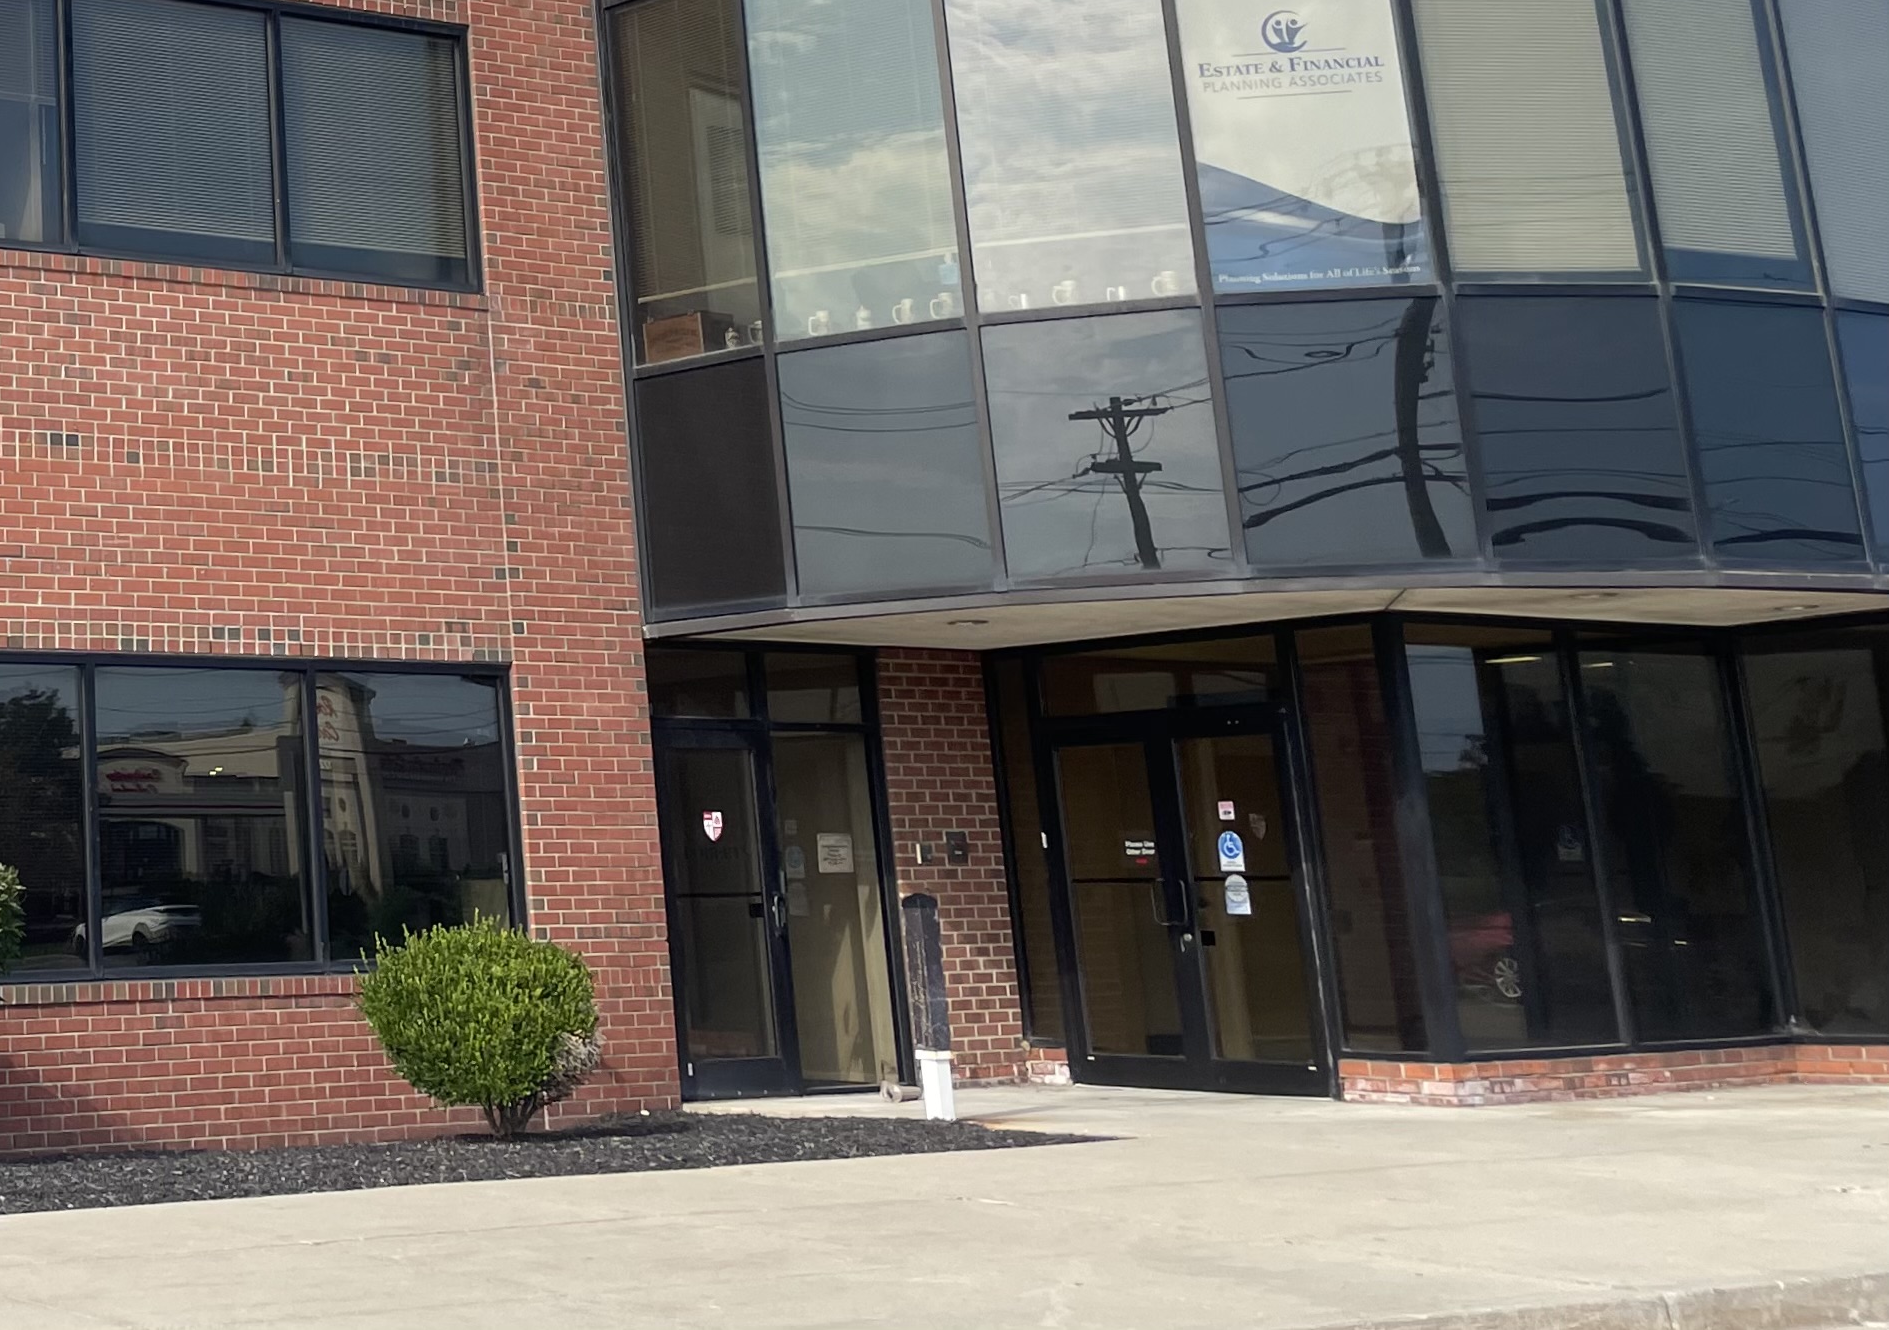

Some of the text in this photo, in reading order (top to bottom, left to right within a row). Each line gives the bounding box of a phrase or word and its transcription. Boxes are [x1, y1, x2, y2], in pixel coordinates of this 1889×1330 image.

[1198, 56, 1385, 78] ESTATE & FINANCIAL
[1203, 71, 1383, 93] PLANNING ASSOCIATES
[1262, 272, 1308, 282] Solutions
[1326, 268, 1341, 278] All
